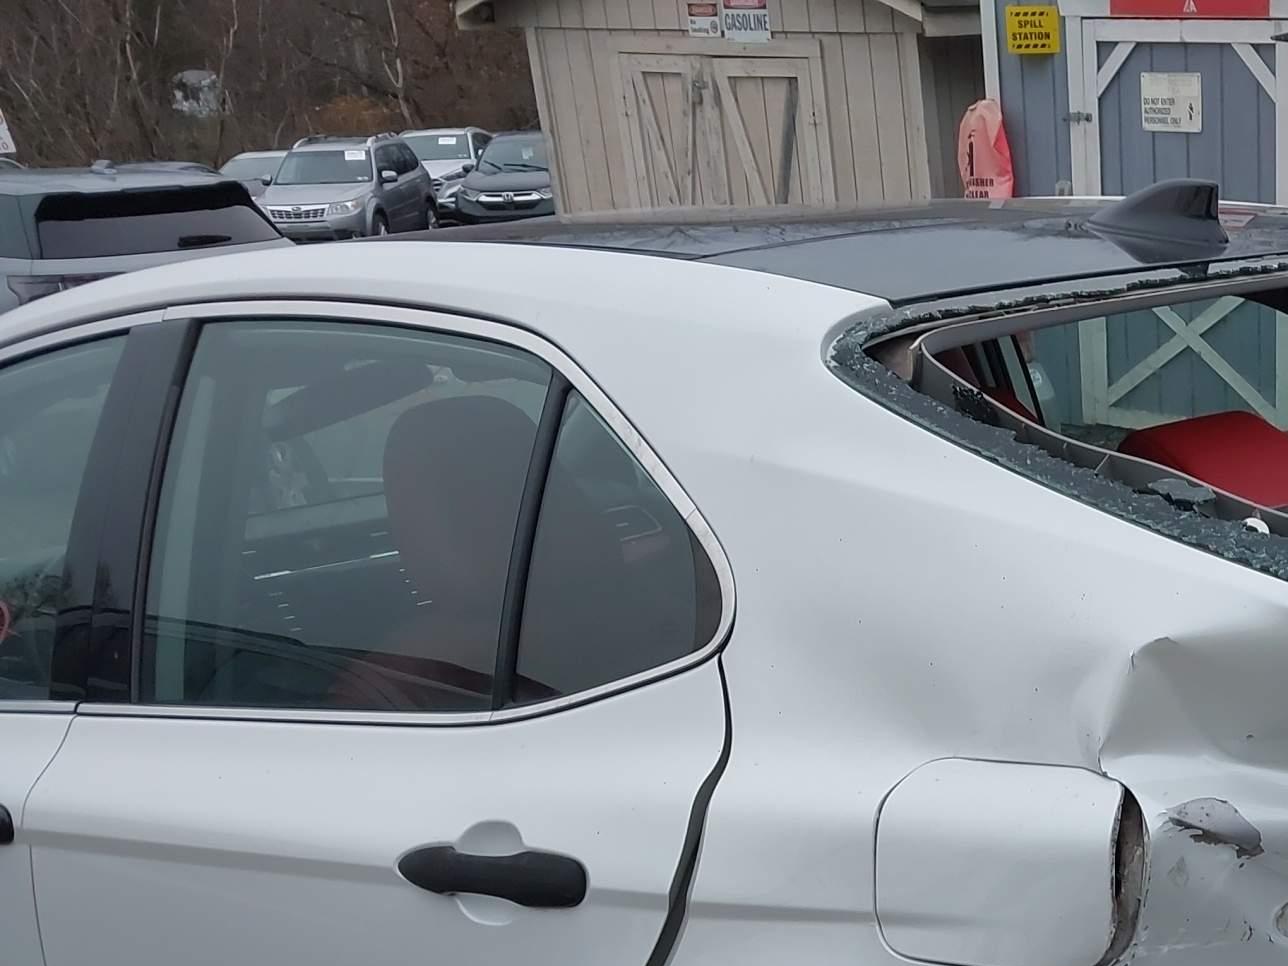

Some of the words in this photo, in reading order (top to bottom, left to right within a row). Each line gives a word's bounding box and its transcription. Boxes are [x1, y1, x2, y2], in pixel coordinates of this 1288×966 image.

[724, 13, 769, 32] GASOLINE
[1017, 19, 1044, 28] SPILL
[1012, 31, 1051, 41] STATION
